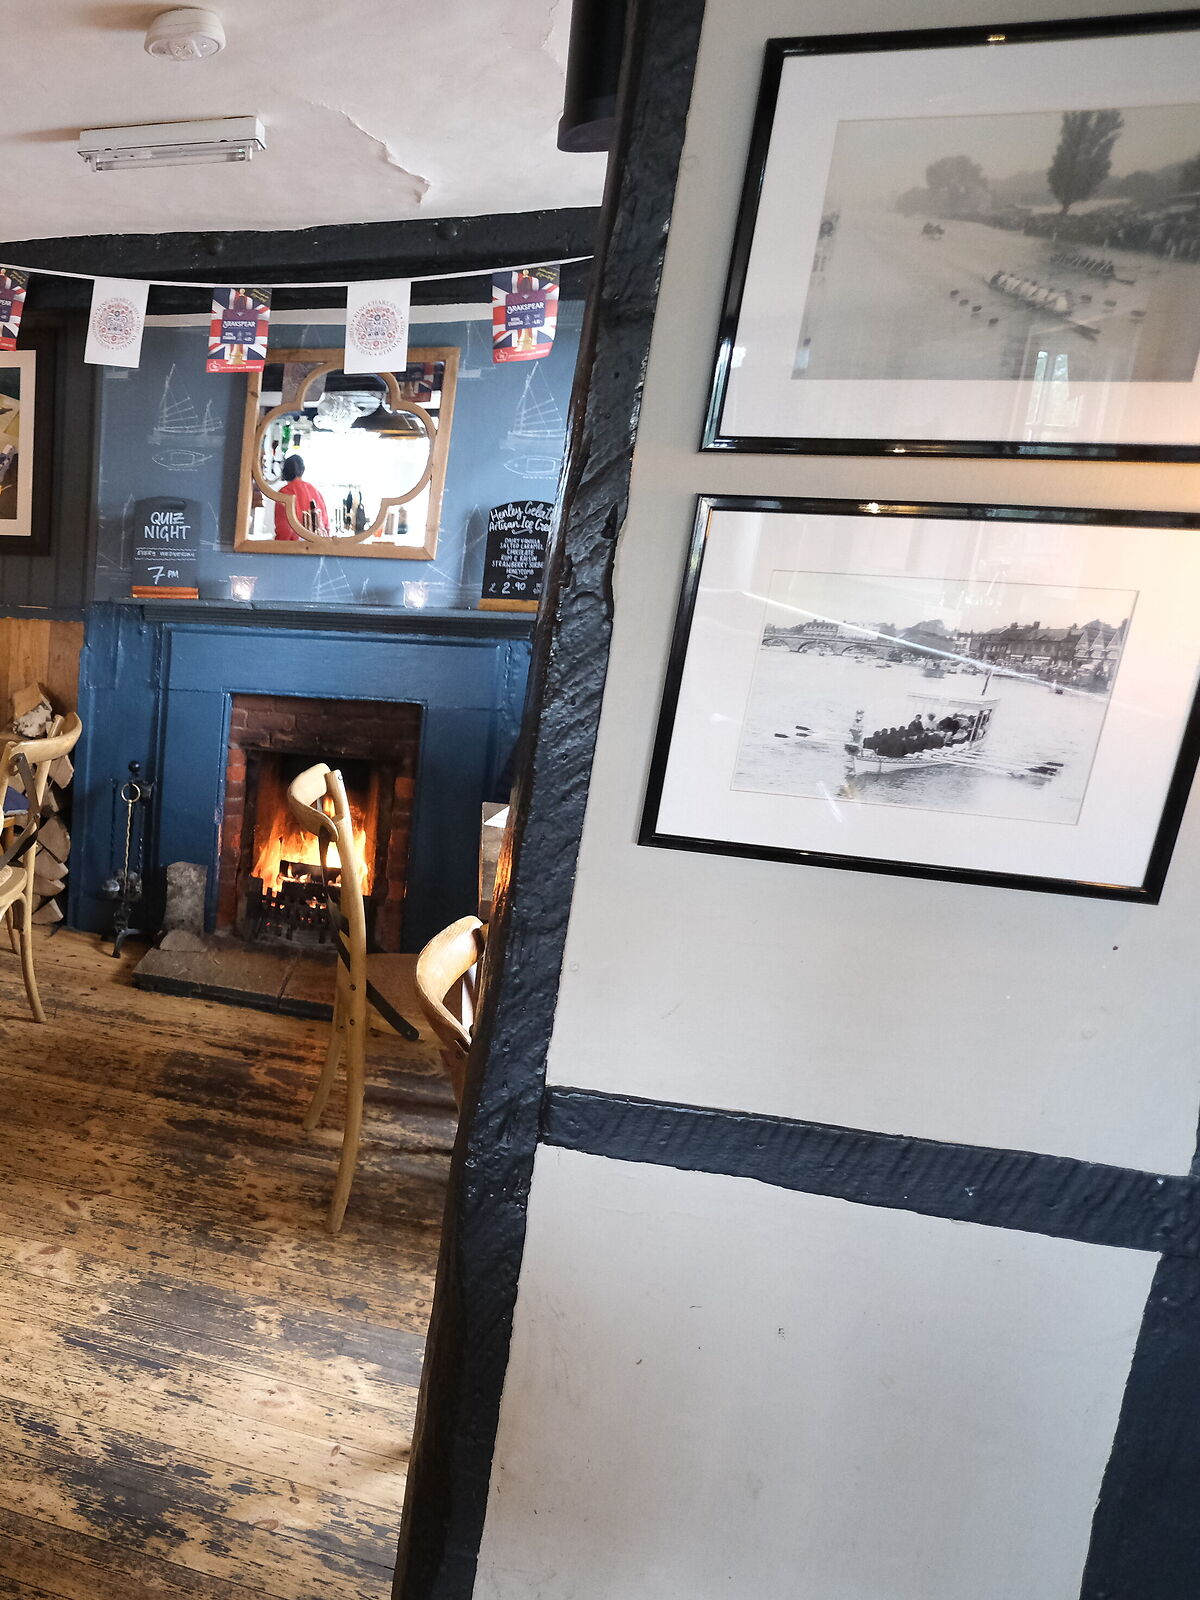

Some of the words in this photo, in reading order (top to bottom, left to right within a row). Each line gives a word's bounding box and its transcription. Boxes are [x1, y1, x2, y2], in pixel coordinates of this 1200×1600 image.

[507, 302, 545, 314] BRAKSPEAR
[150, 511, 185, 526] QUIZ
[490, 503, 523, 521] Henley
[489, 519, 520, 532] Artisan
[520, 516, 535, 530] Ice
[144, 525, 191, 542] NIGHT
[147, 566, 166, 585] 7
[167, 570, 179, 578] PM
